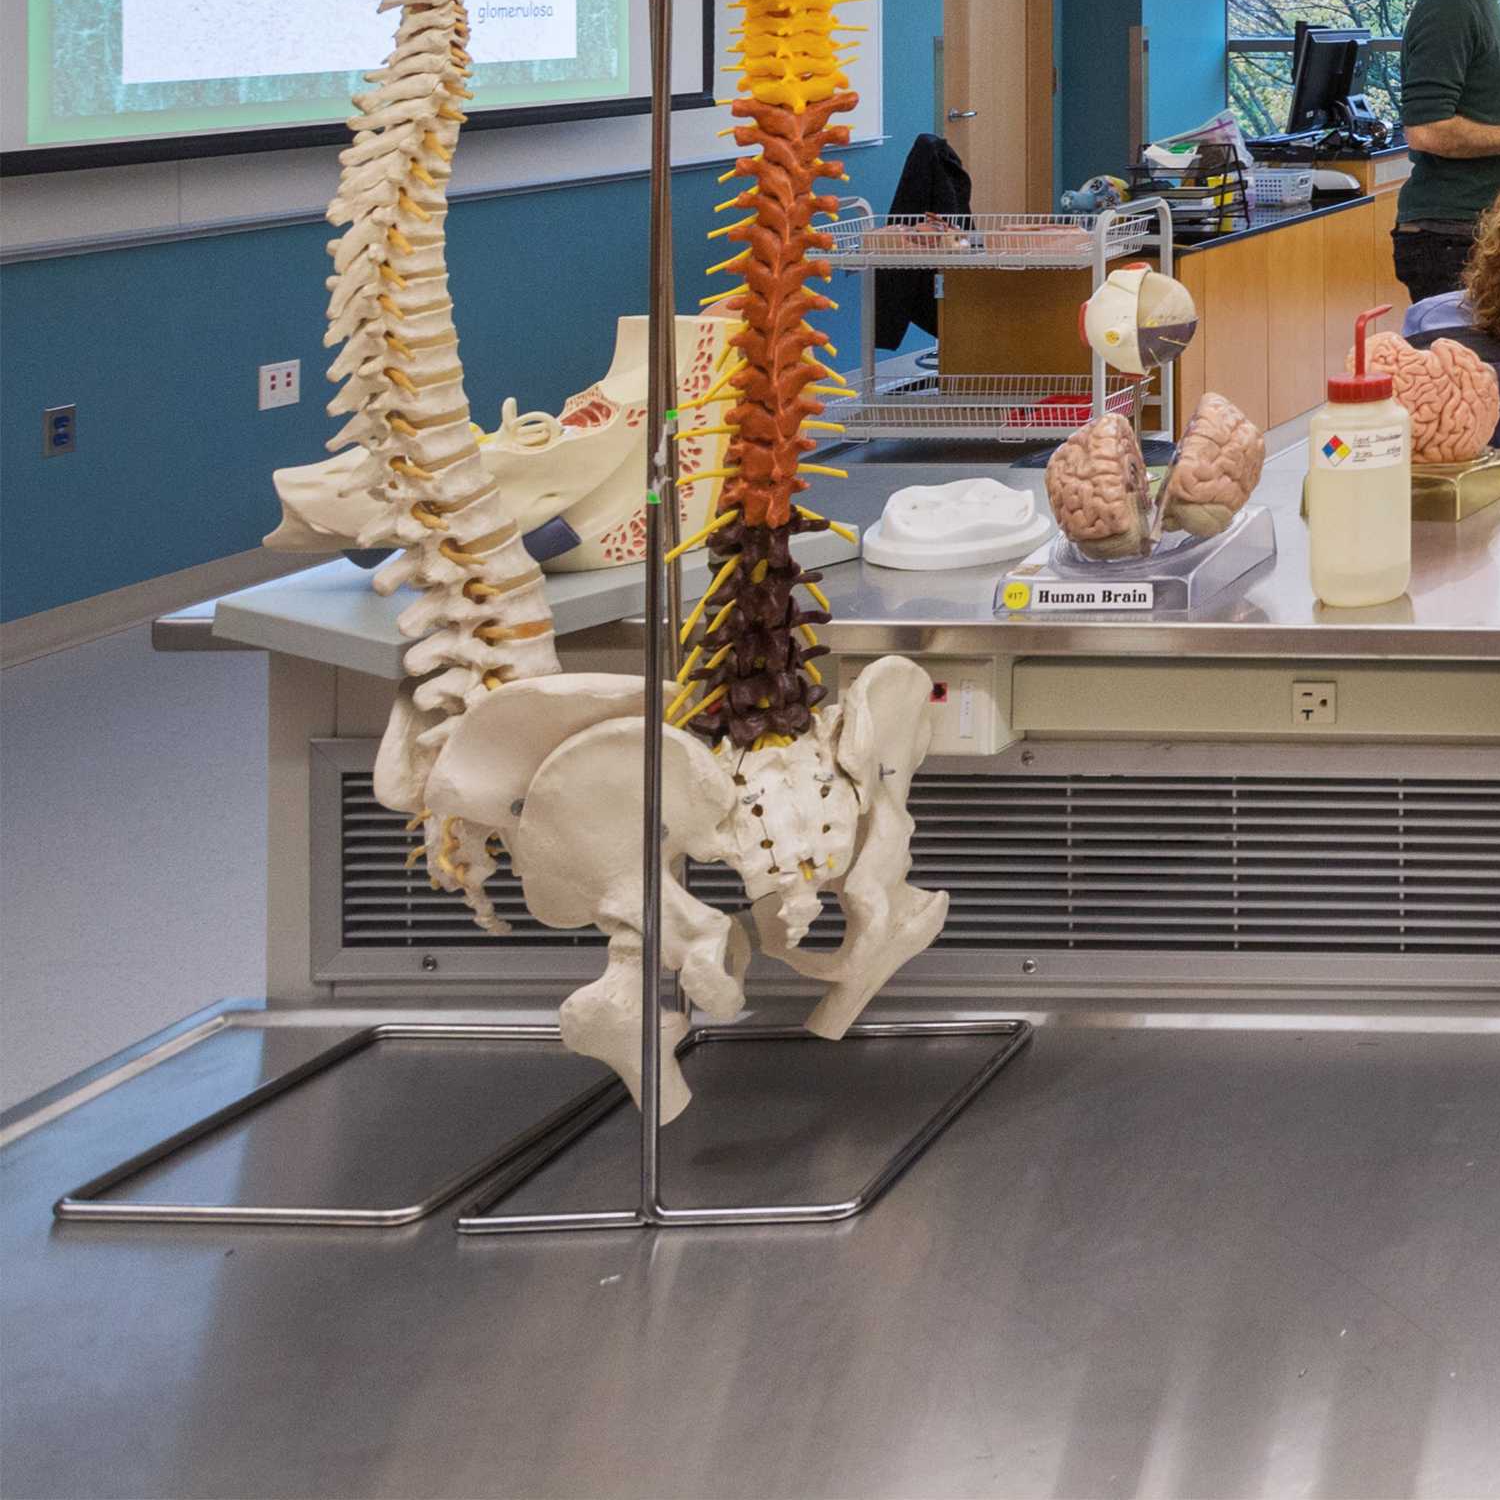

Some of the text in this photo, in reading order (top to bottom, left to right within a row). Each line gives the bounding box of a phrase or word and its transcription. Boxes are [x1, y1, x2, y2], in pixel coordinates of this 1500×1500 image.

[478, 1, 554, 24] glomerulosa
[1038, 589, 1148, 604] Human Brain
